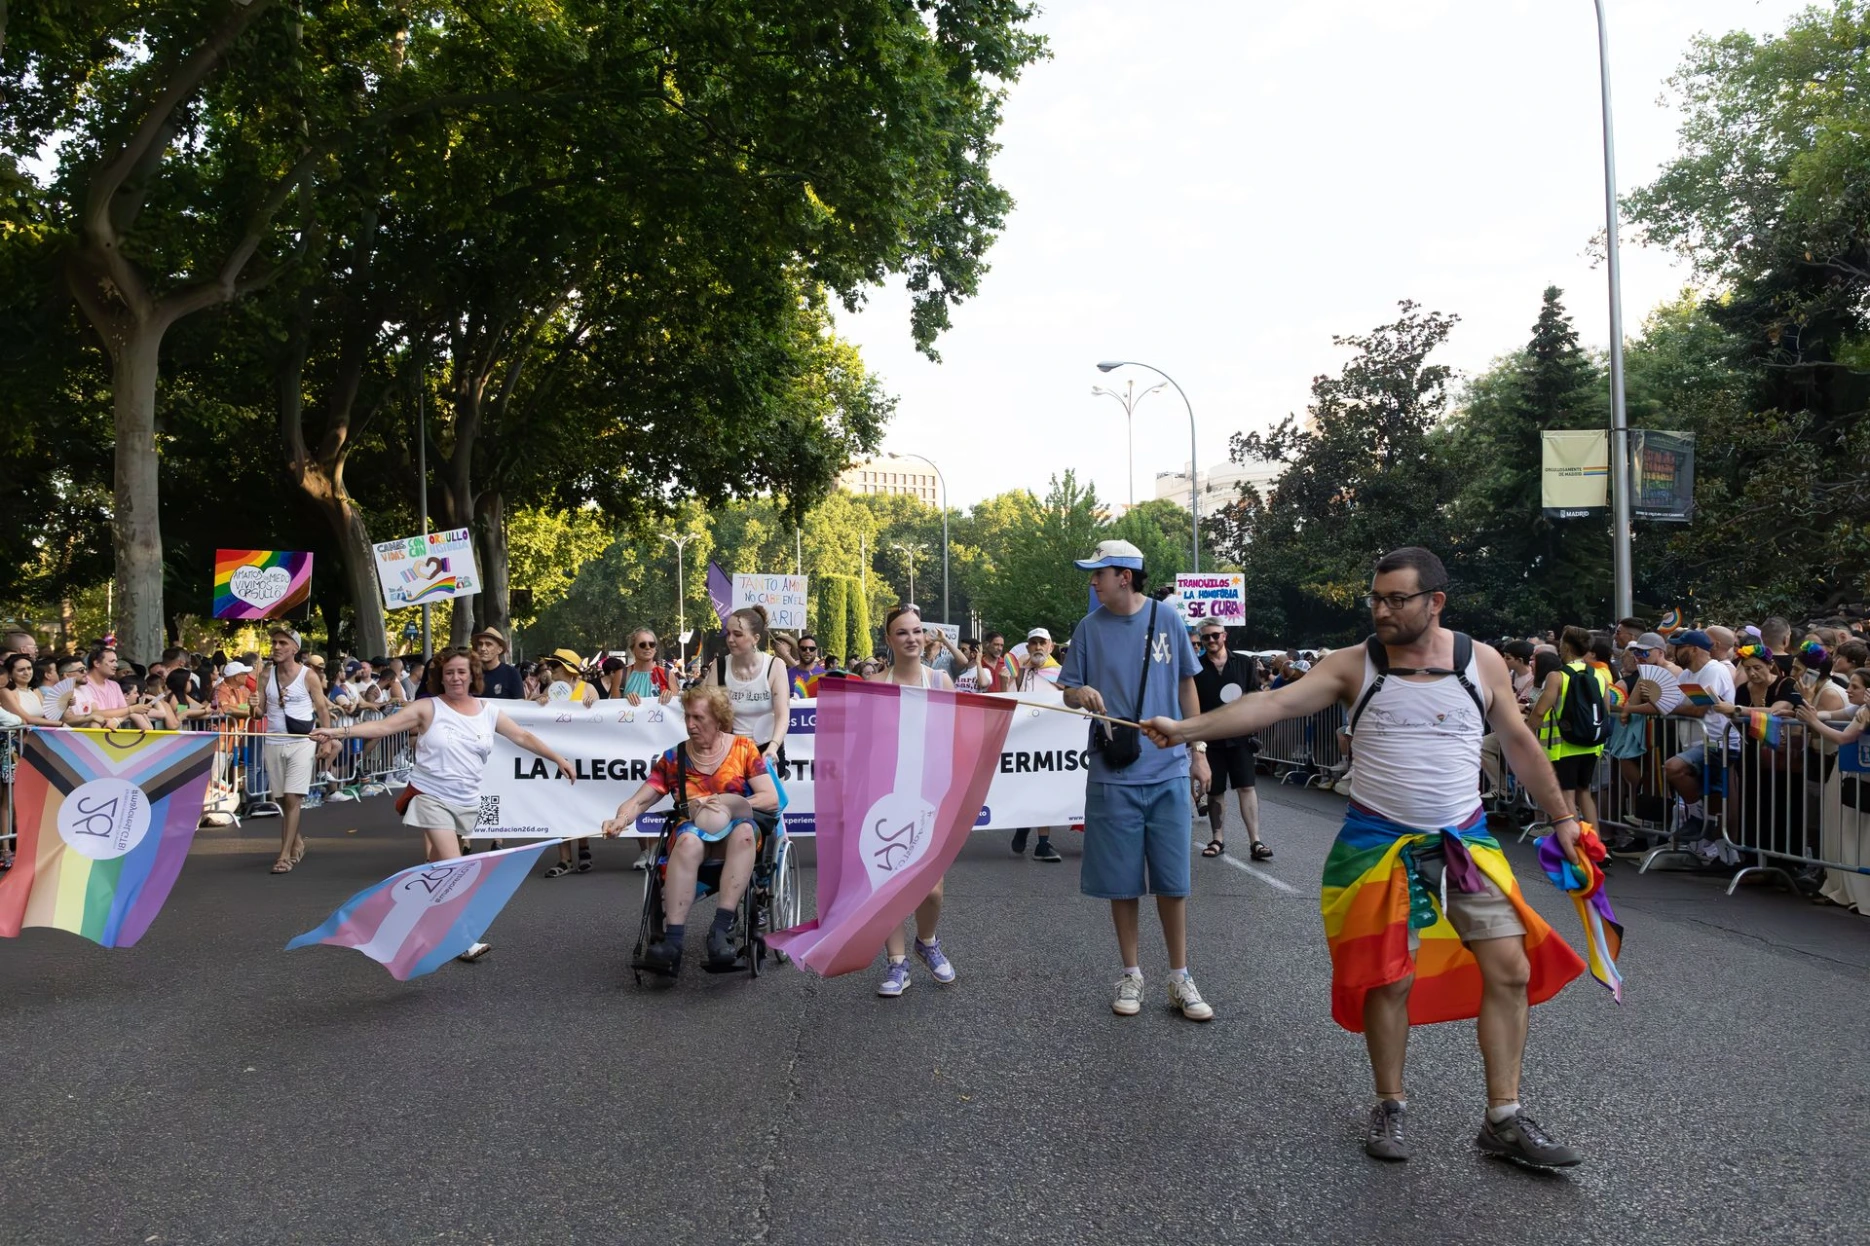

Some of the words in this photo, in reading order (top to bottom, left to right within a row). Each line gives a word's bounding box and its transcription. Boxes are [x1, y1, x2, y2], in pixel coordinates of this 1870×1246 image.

[377, 540, 407, 552] CANAS
[429, 530, 468, 545] ORGULLO
[235, 580, 272, 590] VIVIMOS
[739, 576, 778, 591] TANTO
[782, 577, 806, 592] AMOR
[1177, 579, 1230, 588] TRANQUILOS
[745, 590, 756, 602] NO
[758, 593, 780, 605] CABE
[1183, 590, 1195, 600] LA
[1198, 589, 1239, 599] HOMOFOBIA
[1188, 601, 1206, 618] SE
[1210, 600, 1241, 617] CURA
[768, 610, 804, 627] ARIO
[514, 757, 550, 779] LA
[554, 754, 660, 781] LEGRÍ
[1000, 750, 1089, 773] ERMIS
